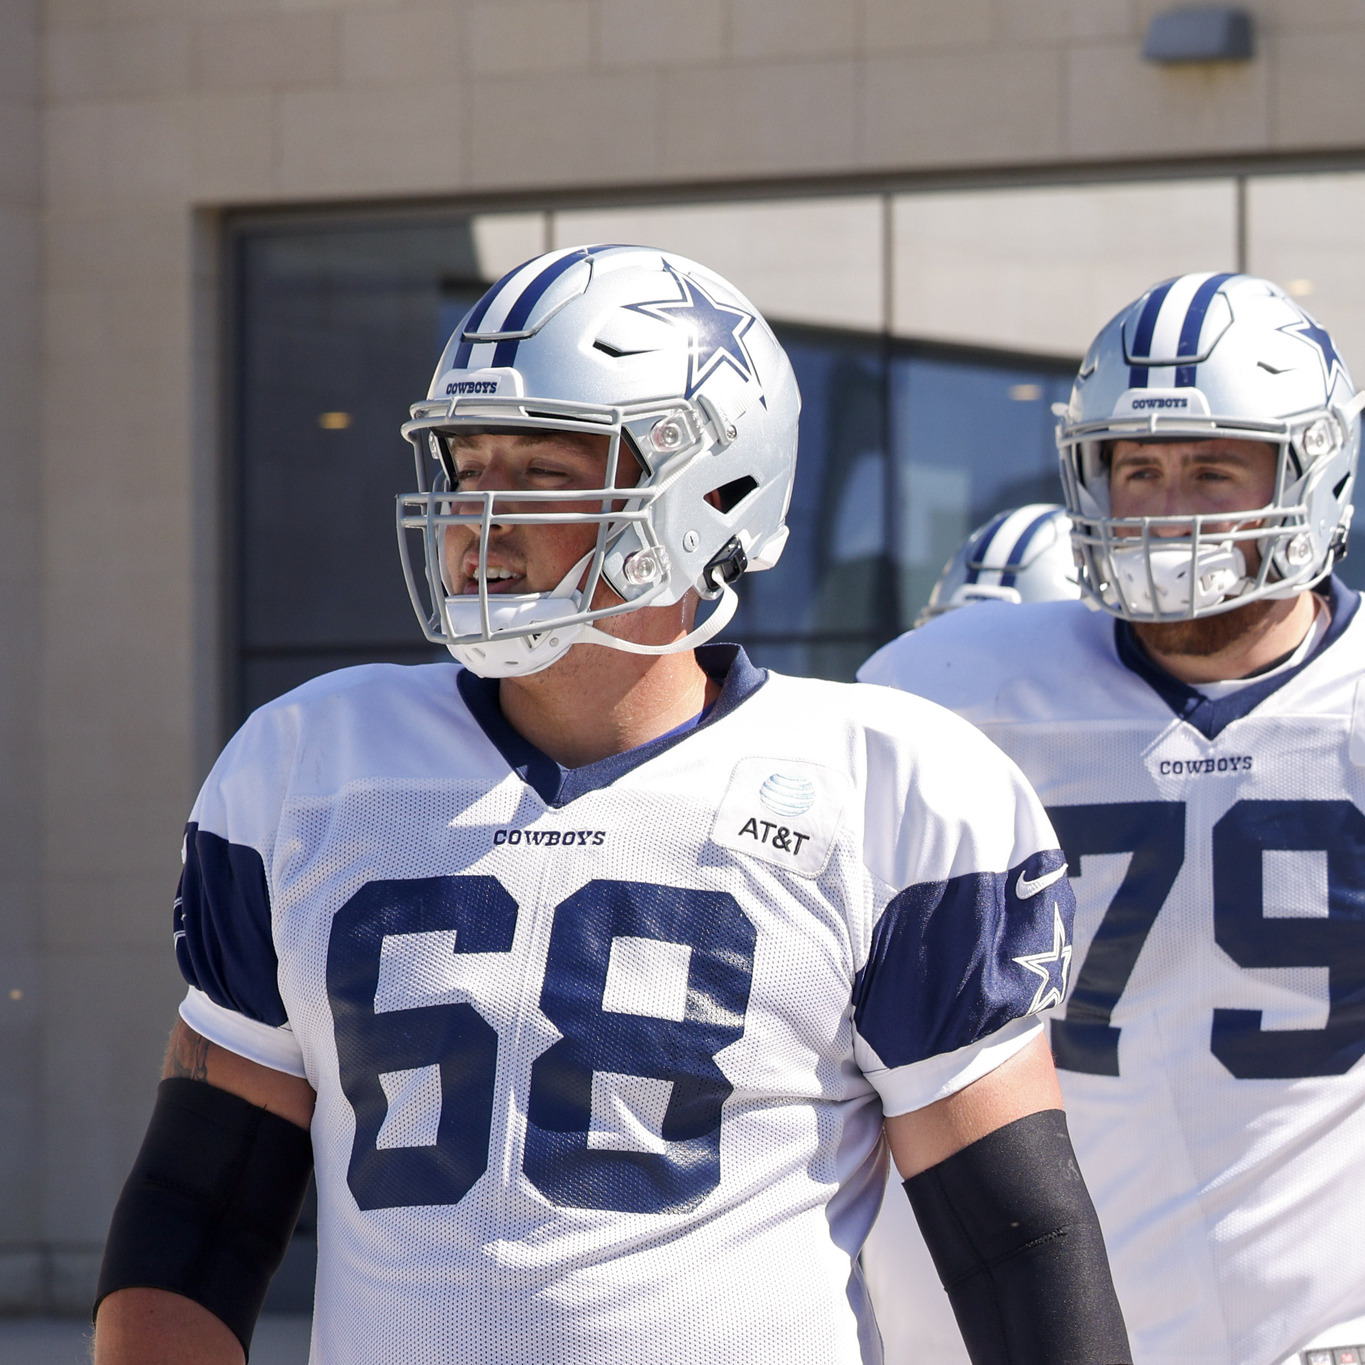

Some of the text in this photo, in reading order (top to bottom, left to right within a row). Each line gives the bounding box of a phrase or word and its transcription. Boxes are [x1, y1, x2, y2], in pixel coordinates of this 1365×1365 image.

[446, 382, 497, 395] COWBOYS
[1132, 398, 1188, 409] COWBOYS
[1160, 756, 1252, 775] COWBOYS
[493, 829, 606, 846] COWBOYS
[738, 818, 810, 856] AT&T
[326, 875, 758, 1214] 68
